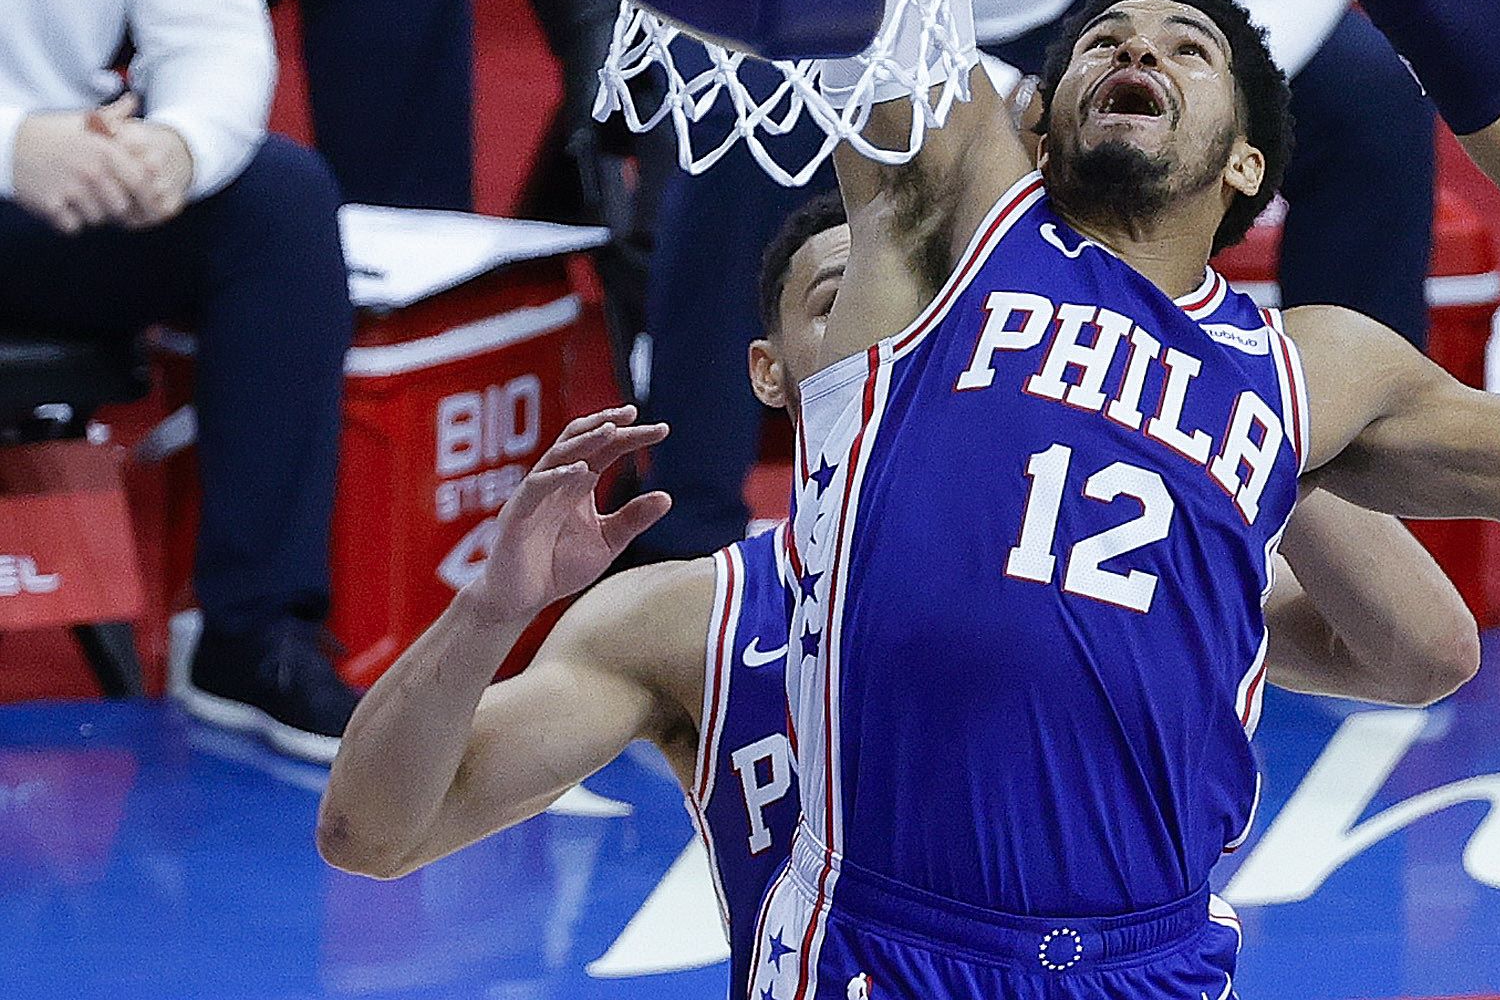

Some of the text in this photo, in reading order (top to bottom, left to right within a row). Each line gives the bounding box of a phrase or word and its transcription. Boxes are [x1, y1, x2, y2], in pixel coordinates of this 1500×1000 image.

[1206, 328, 1258, 347] tubHub
[436, 374, 542, 478] BIO
[955, 290, 1284, 525] PHILA
[1002, 443, 1176, 614] 12
[729, 732, 791, 857] P
